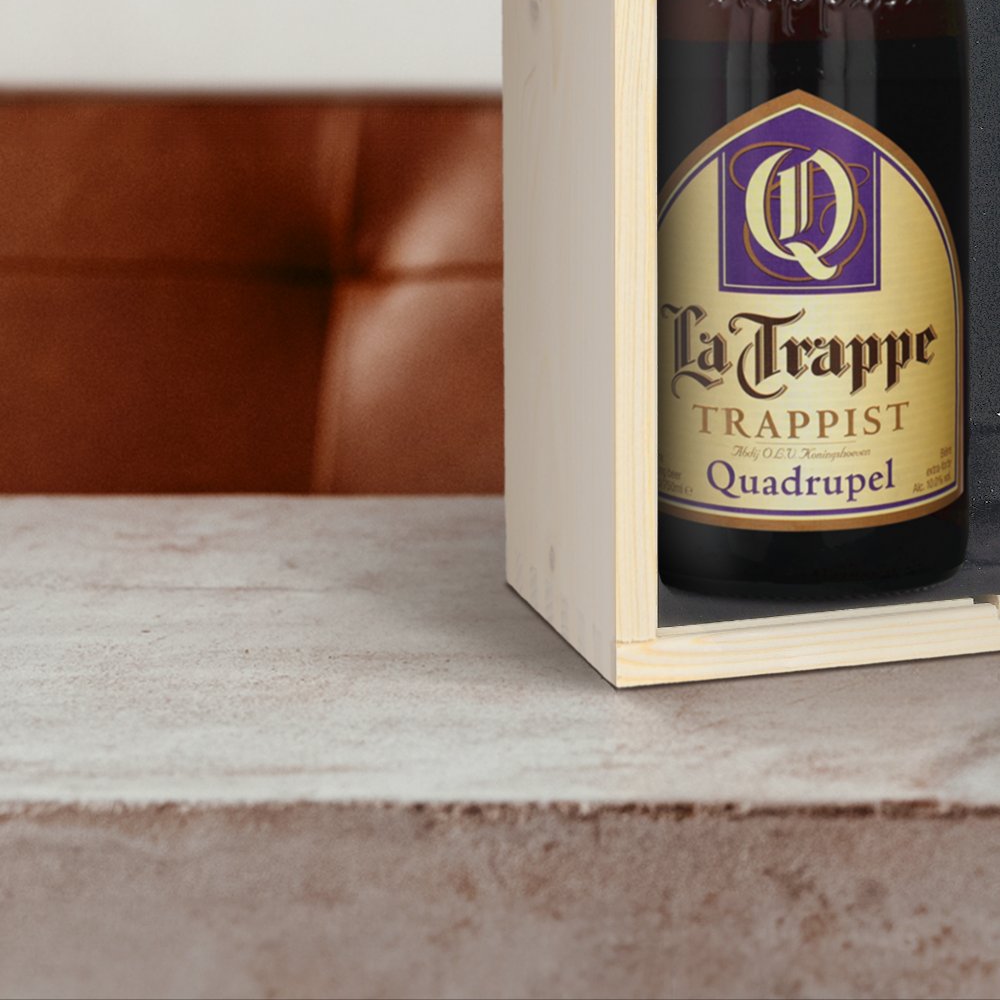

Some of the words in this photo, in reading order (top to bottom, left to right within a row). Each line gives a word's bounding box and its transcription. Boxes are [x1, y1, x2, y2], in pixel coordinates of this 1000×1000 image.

[745, 147, 858, 281] Q
[660, 303, 733, 399] La
[727, 307, 938, 400] Trappe
[692, 401, 910, 439] TRAPPIST
[798, 446, 872, 462] Koningshoeven
[707, 458, 896, 502] Quadrupel
